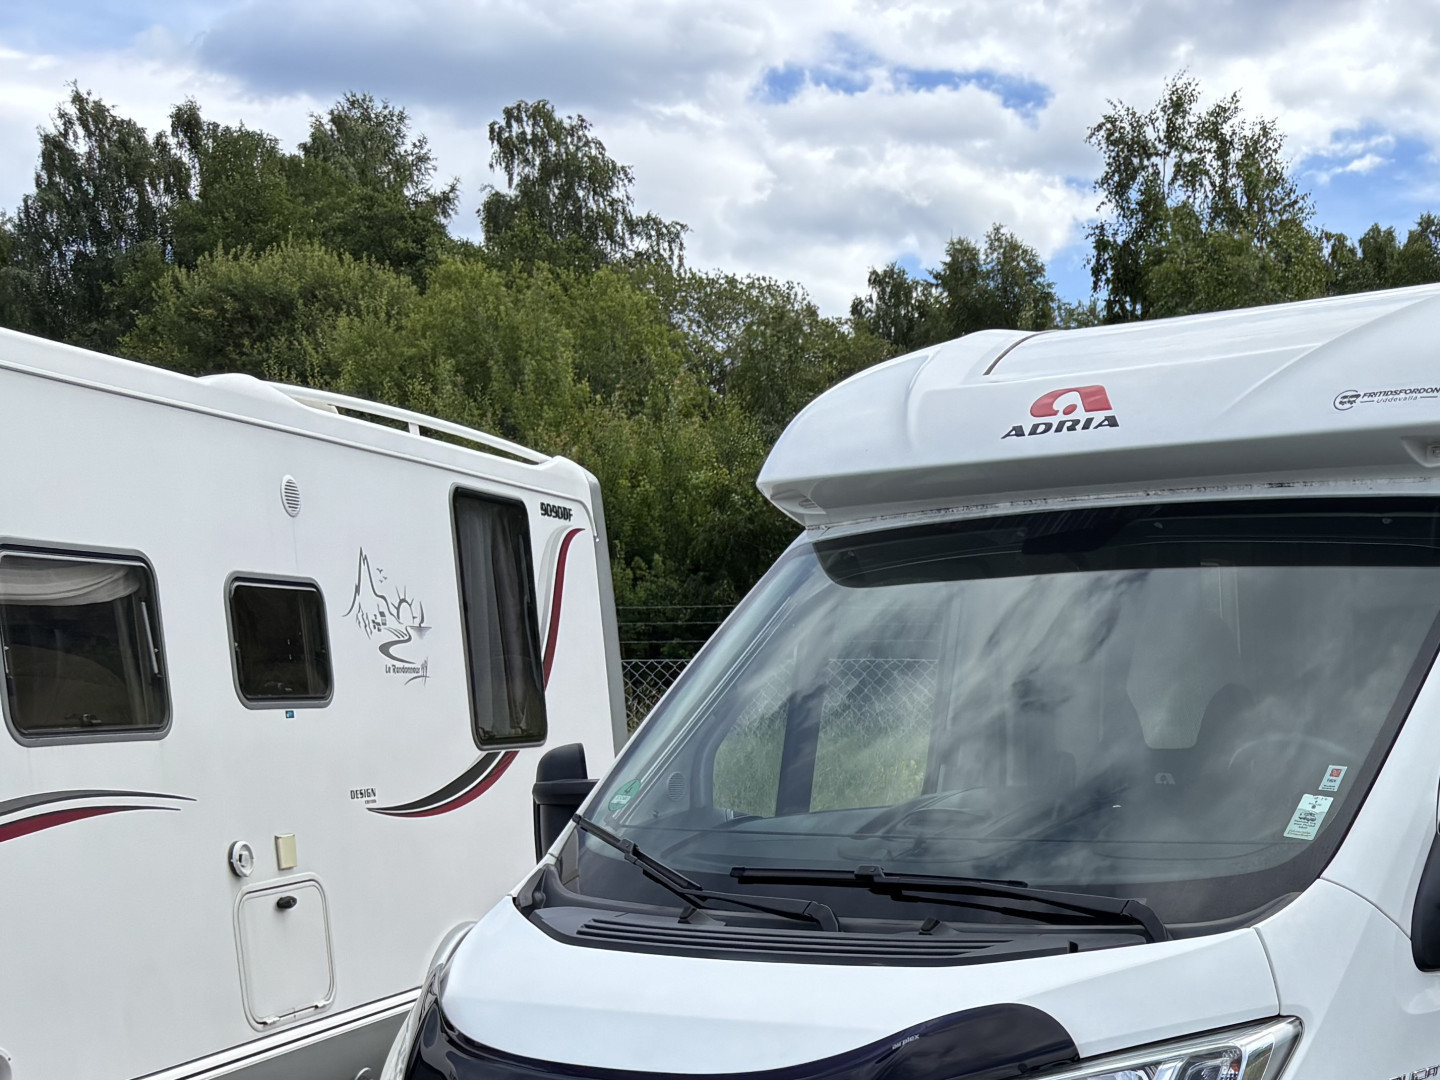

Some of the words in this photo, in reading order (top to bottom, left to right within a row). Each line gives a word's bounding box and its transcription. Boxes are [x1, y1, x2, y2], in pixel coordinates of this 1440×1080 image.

[1376, 395, 1418, 404] Uddevalla
[1001, 415, 1120, 440] ADRIA
[540, 501, 573, 522] 9090DF
[350, 788, 376, 800] DESIGN
[892, 1034, 920, 1050] airplex
